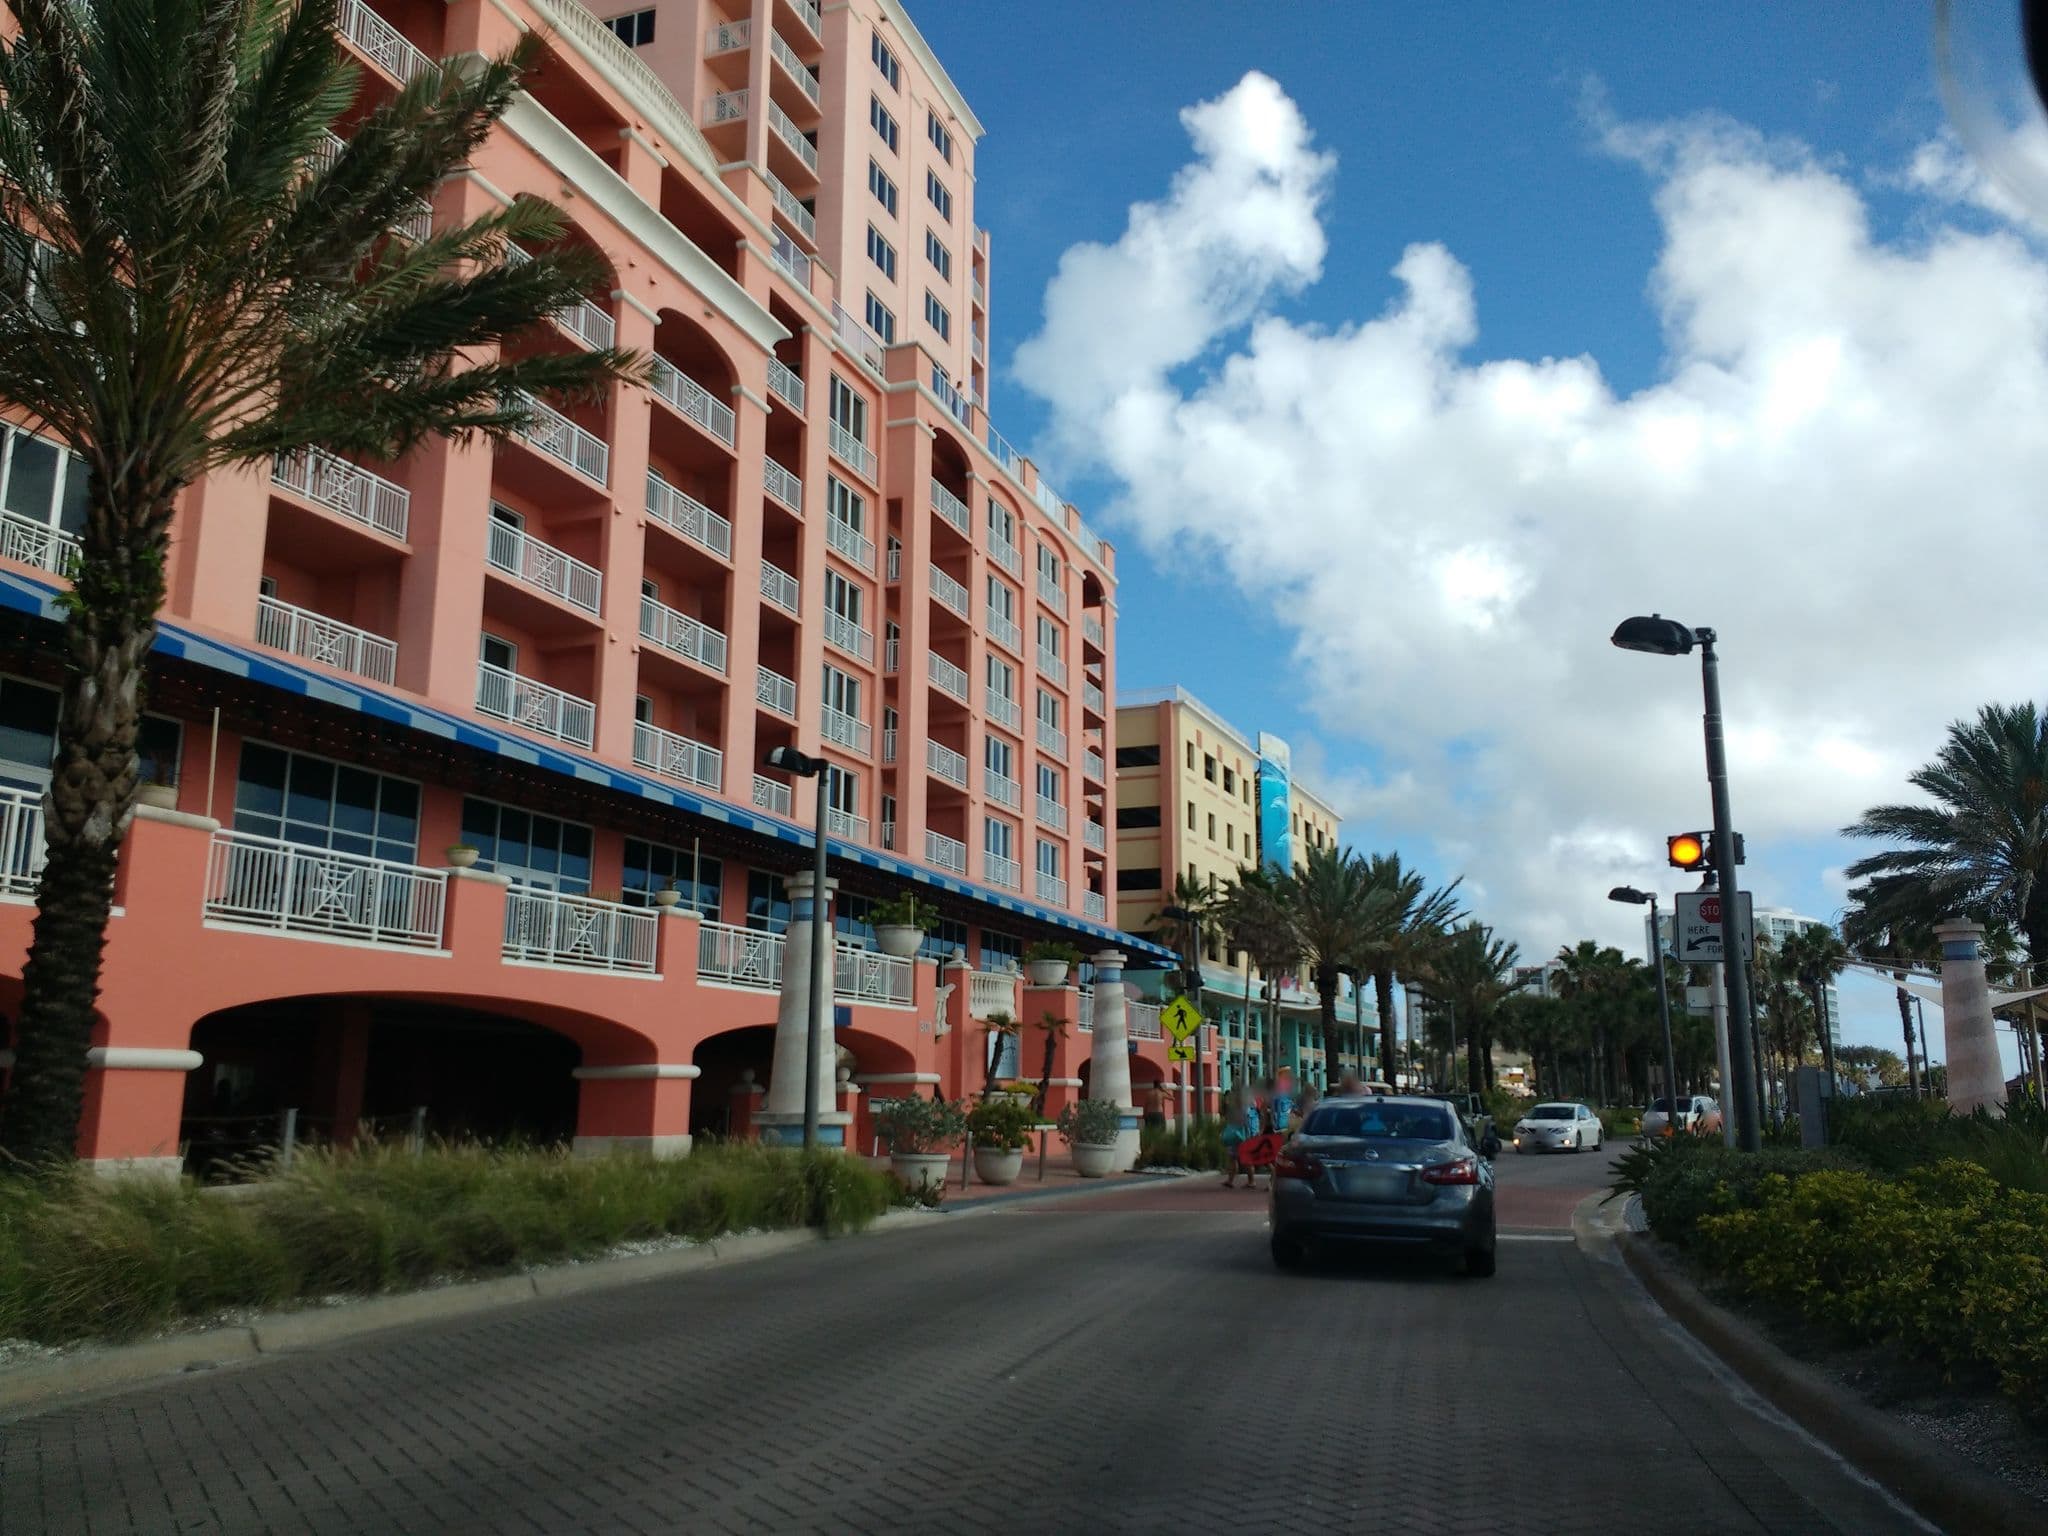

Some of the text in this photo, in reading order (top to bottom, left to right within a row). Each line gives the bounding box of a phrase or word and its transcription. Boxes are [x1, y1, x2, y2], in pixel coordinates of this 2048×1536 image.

[1701, 905, 1721, 916] STO
[1687, 925, 1711, 935] HERE
[1707, 944, 1724, 954] FOR
